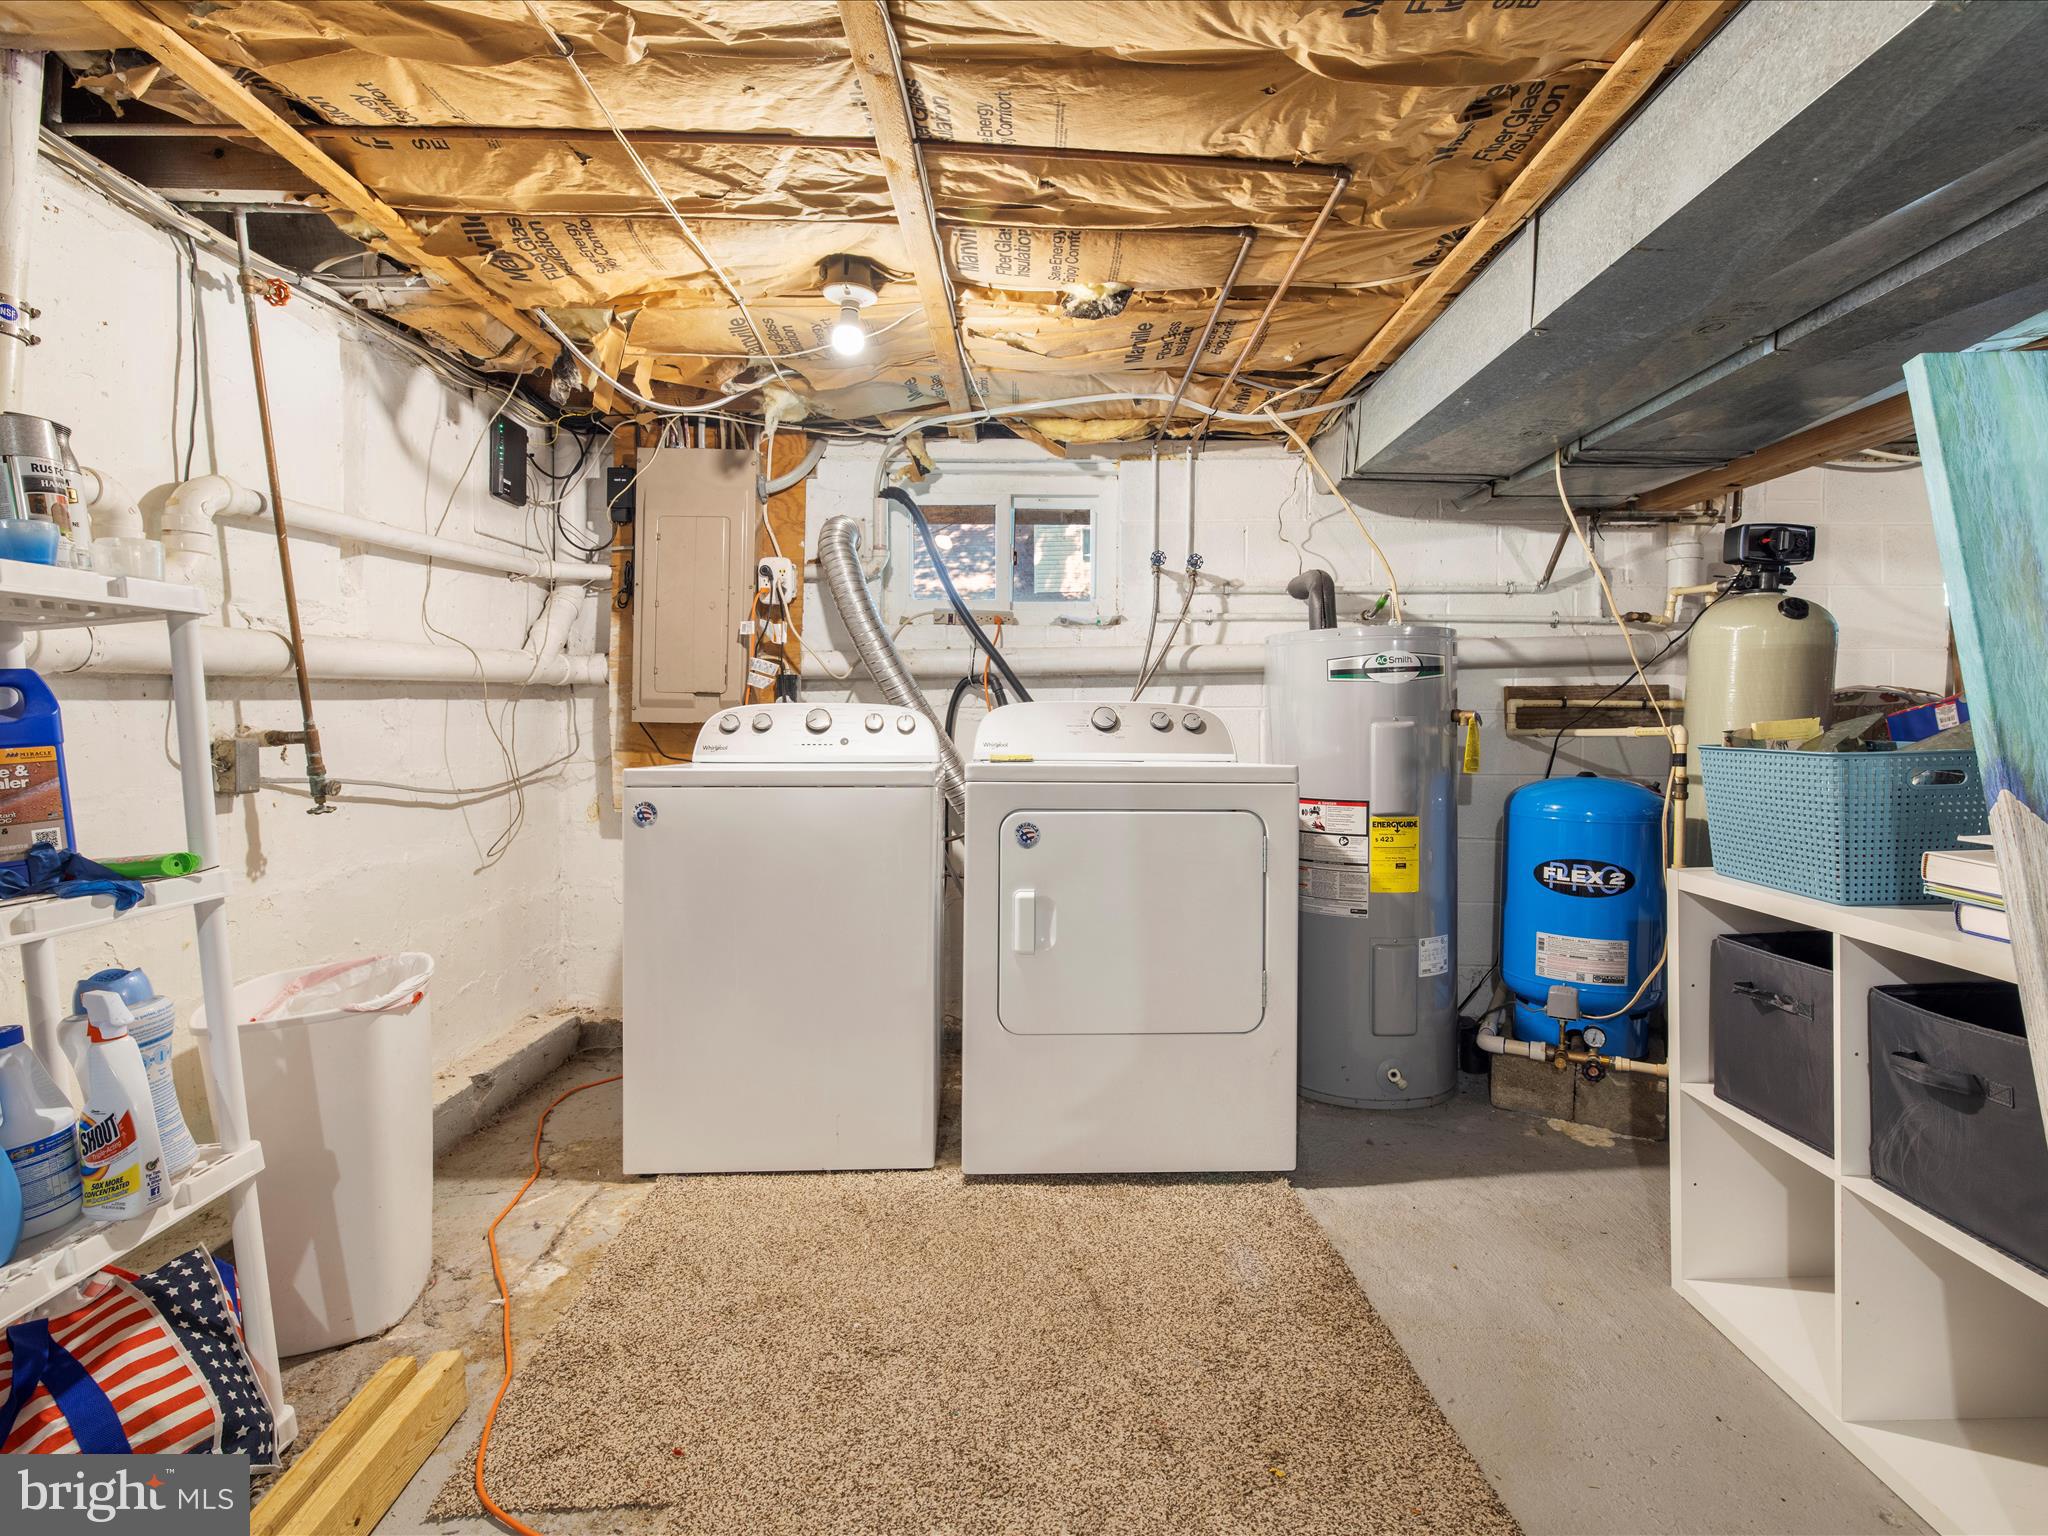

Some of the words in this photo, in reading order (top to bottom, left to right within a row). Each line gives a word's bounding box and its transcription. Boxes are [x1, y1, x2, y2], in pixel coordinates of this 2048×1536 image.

[1502, 80, 1546, 129] Glas
[507, 217, 537, 251] Glas
[579, 218, 609, 257] Comfo
[1065, 230, 1082, 264] Comfo
[995, 254, 1012, 277] Fiber
[728, 317, 765, 355] anville
[1124, 321, 1154, 364] Manville
[30, 462, 65, 478] RUST-O
[14, 764, 30, 778] &
[1543, 866, 1604, 885] FLEX
[1608, 872, 1626, 885] 2
[80, 1113, 119, 1156] SHOUT
[84, 1181, 130, 1198] CONCENTRATED
[105, 1176, 124, 1188] MORE
